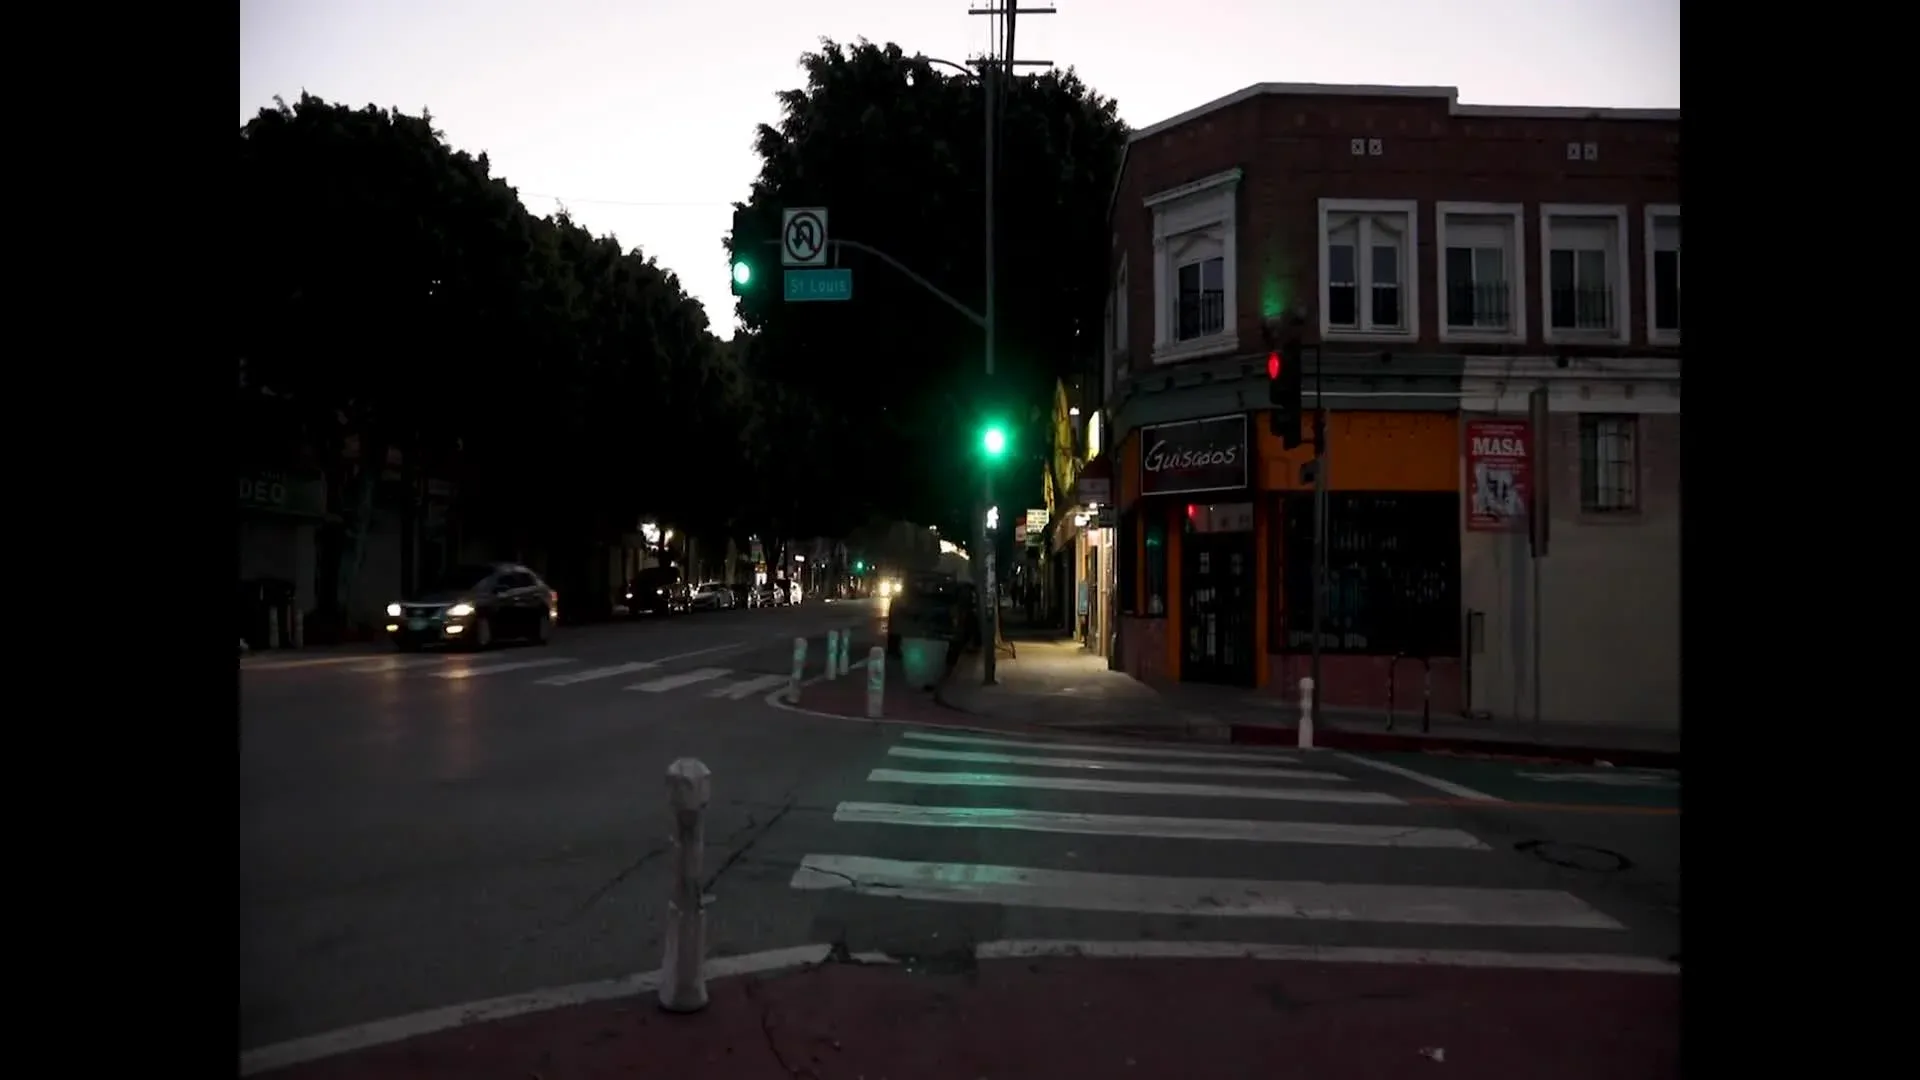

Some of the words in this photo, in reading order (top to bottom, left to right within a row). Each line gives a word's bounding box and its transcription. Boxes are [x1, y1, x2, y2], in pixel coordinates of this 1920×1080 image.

[791, 279, 804, 293] St
[810, 279, 847, 293] Louis
[1144, 440, 1237, 472] Guisados
[1471, 437, 1526, 456] MASA
